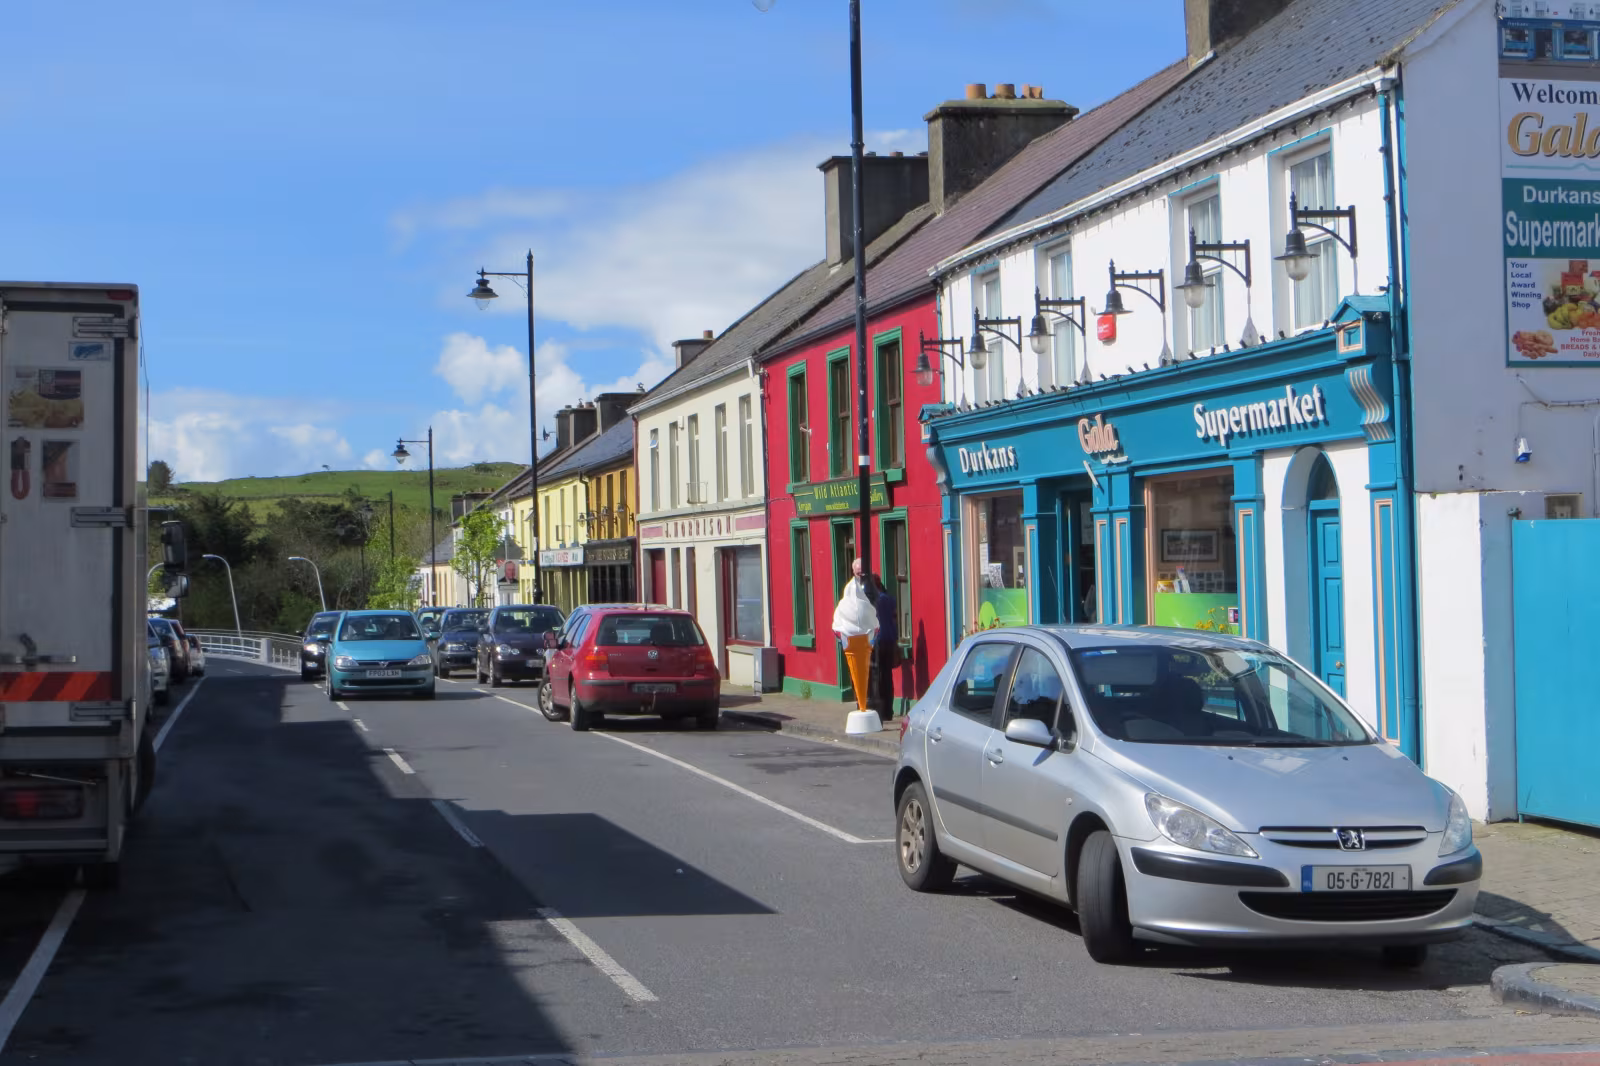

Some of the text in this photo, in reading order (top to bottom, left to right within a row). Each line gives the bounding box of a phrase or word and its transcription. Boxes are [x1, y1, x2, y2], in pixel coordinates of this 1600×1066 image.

[1511, 82, 1600, 105] Welcom
[1522, 185, 1600, 204] Durkans
[1510, 261, 1528, 269] Your
[1510, 271, 1532, 279] Local
[1511, 291, 1542, 300] Winning
[1511, 301, 1531, 309] Shop
[1193, 384, 1324, 447] Supermarket
[1077, 413, 1119, 455] Gala
[959, 441, 1016, 473] Durkans
[813, 485, 828, 500] Wild
[829, 482, 858, 498] Atlantic
[1327, 871, 1394, 889] 05-G-7821
